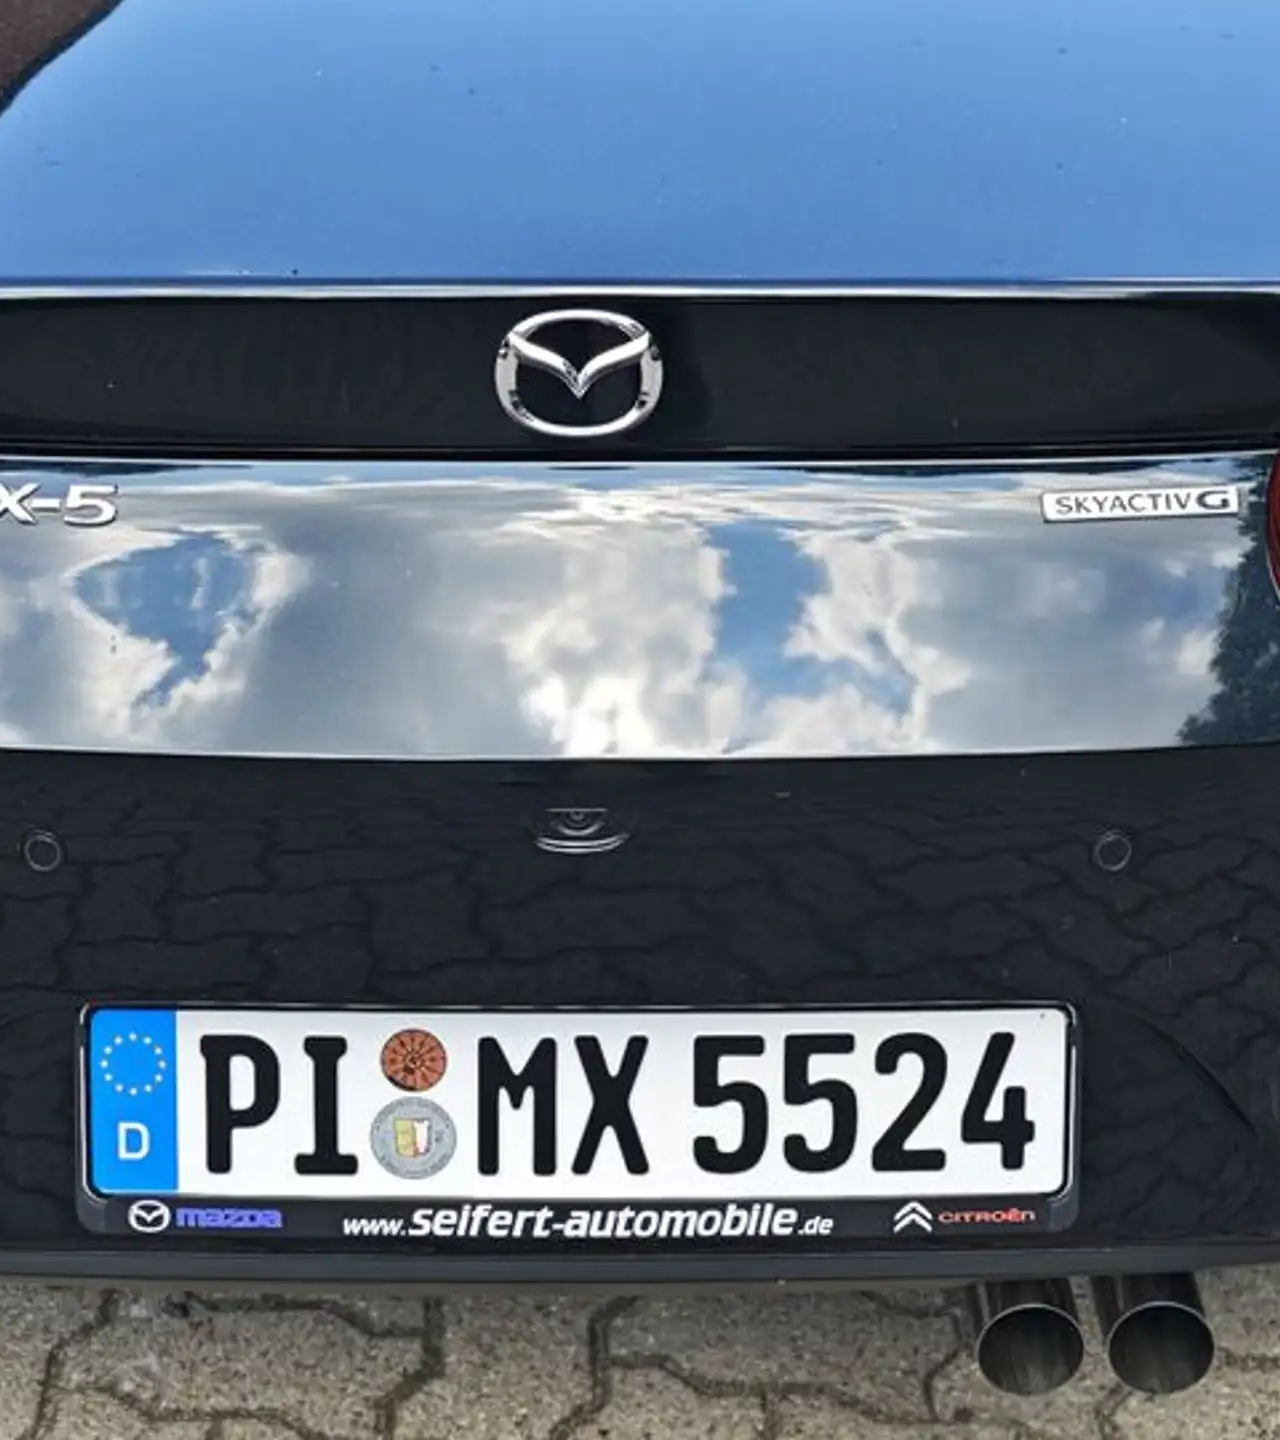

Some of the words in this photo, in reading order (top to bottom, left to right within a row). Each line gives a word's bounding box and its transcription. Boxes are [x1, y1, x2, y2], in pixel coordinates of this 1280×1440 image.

[199, 1033, 358, 1177] PI
[476, 1034, 651, 1177] MX
[691, 1031, 1036, 1175] 5524
[117, 1122, 150, 1160] D
[342, 1202, 834, 1237] www.seifert-automobile.de
